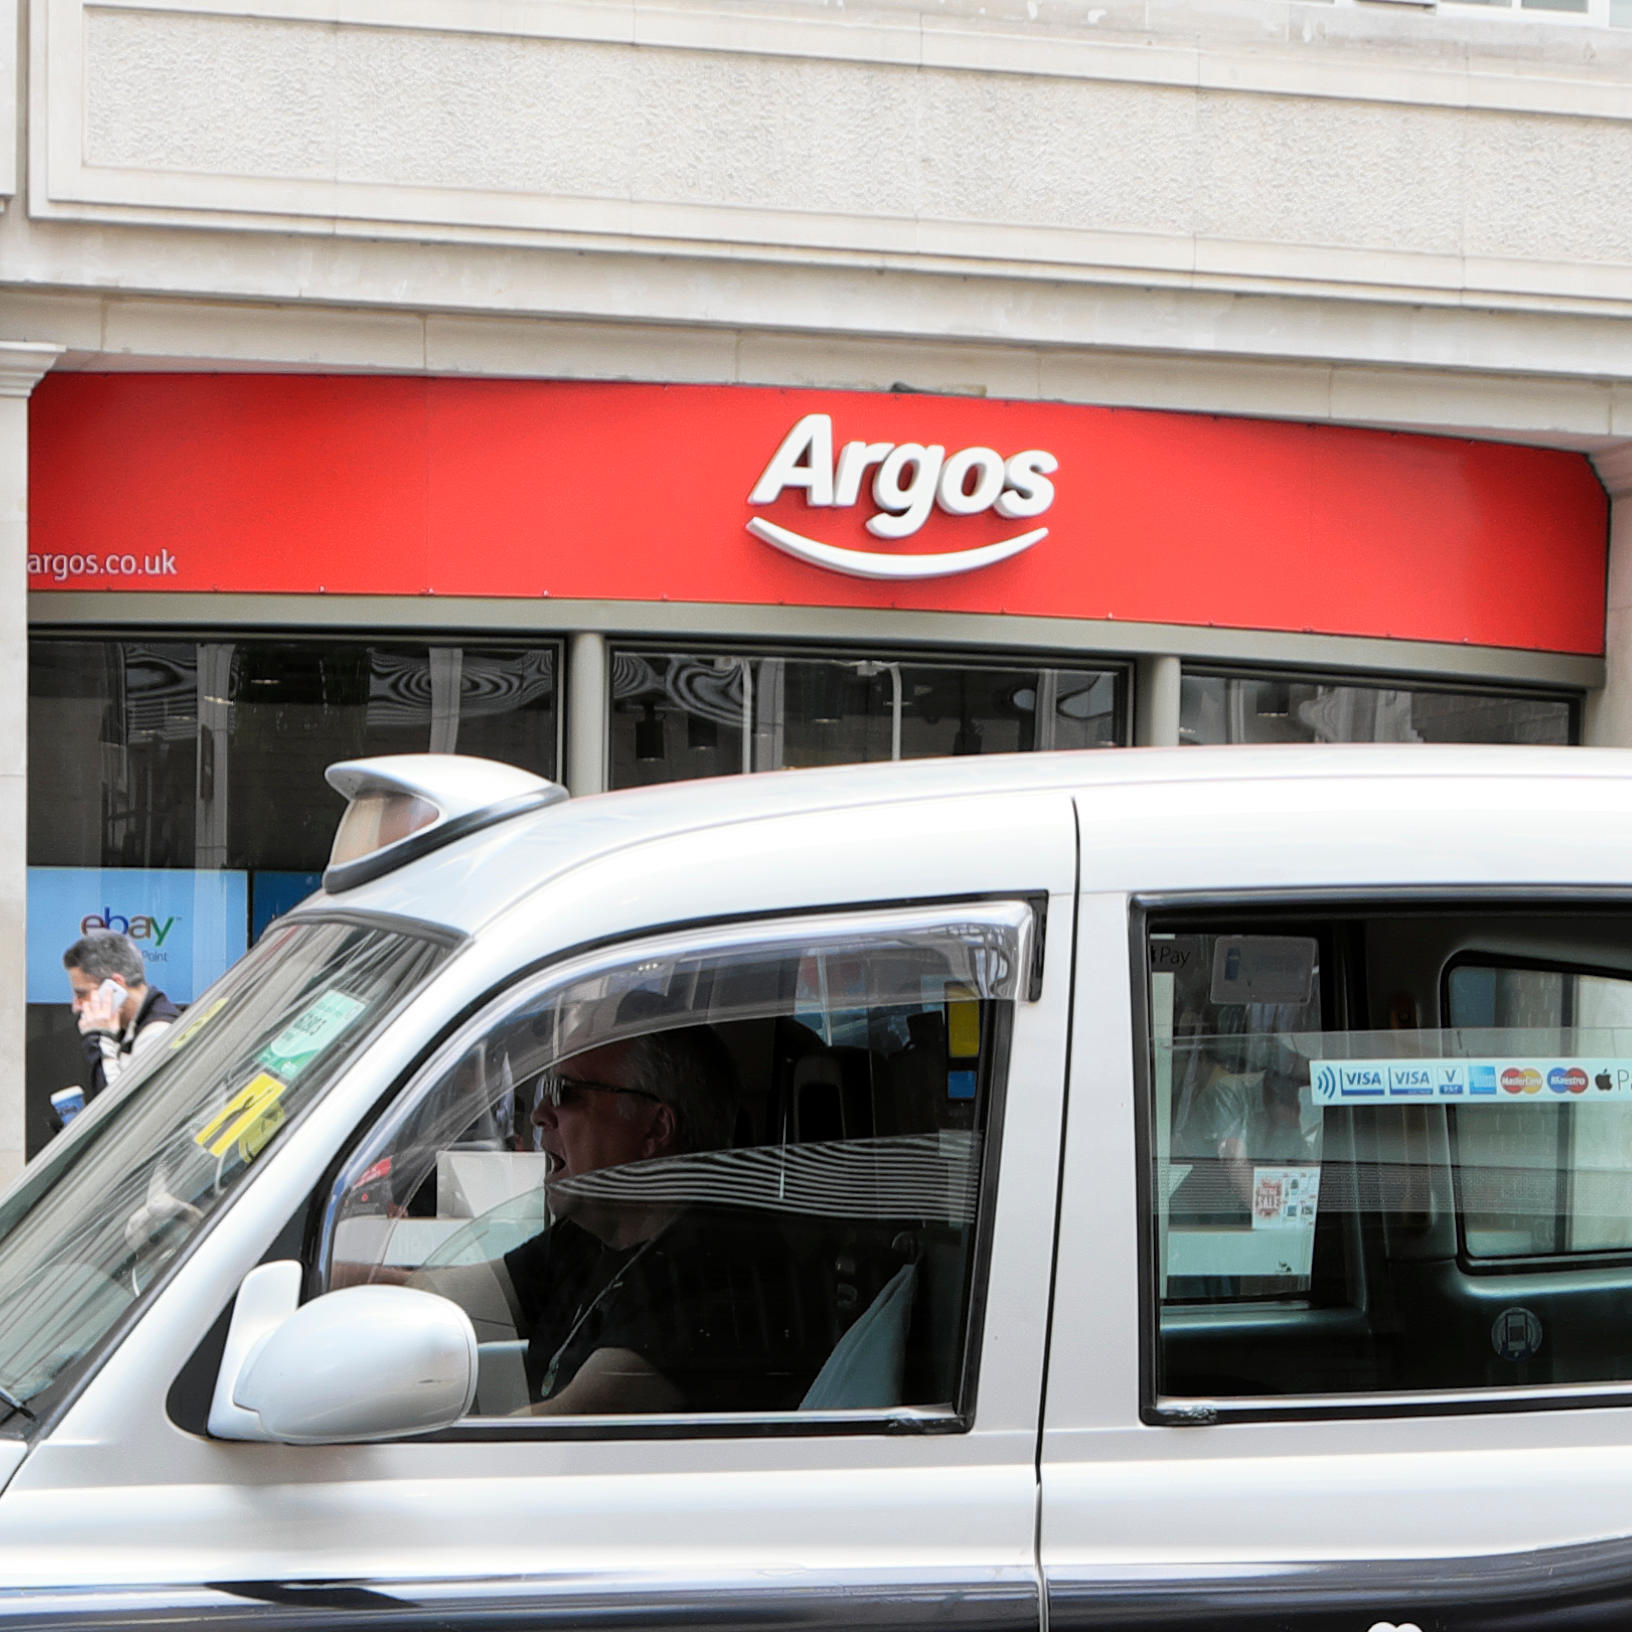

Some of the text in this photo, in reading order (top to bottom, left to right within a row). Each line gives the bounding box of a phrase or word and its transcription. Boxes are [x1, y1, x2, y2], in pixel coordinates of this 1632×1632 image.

[747, 413, 1058, 539] Argos
[27, 548, 178, 582] argos.co.uk
[80, 906, 175, 948] ebay
[1346, 1070, 1381, 1086] VISA
[1394, 1070, 1430, 1085] VISA
